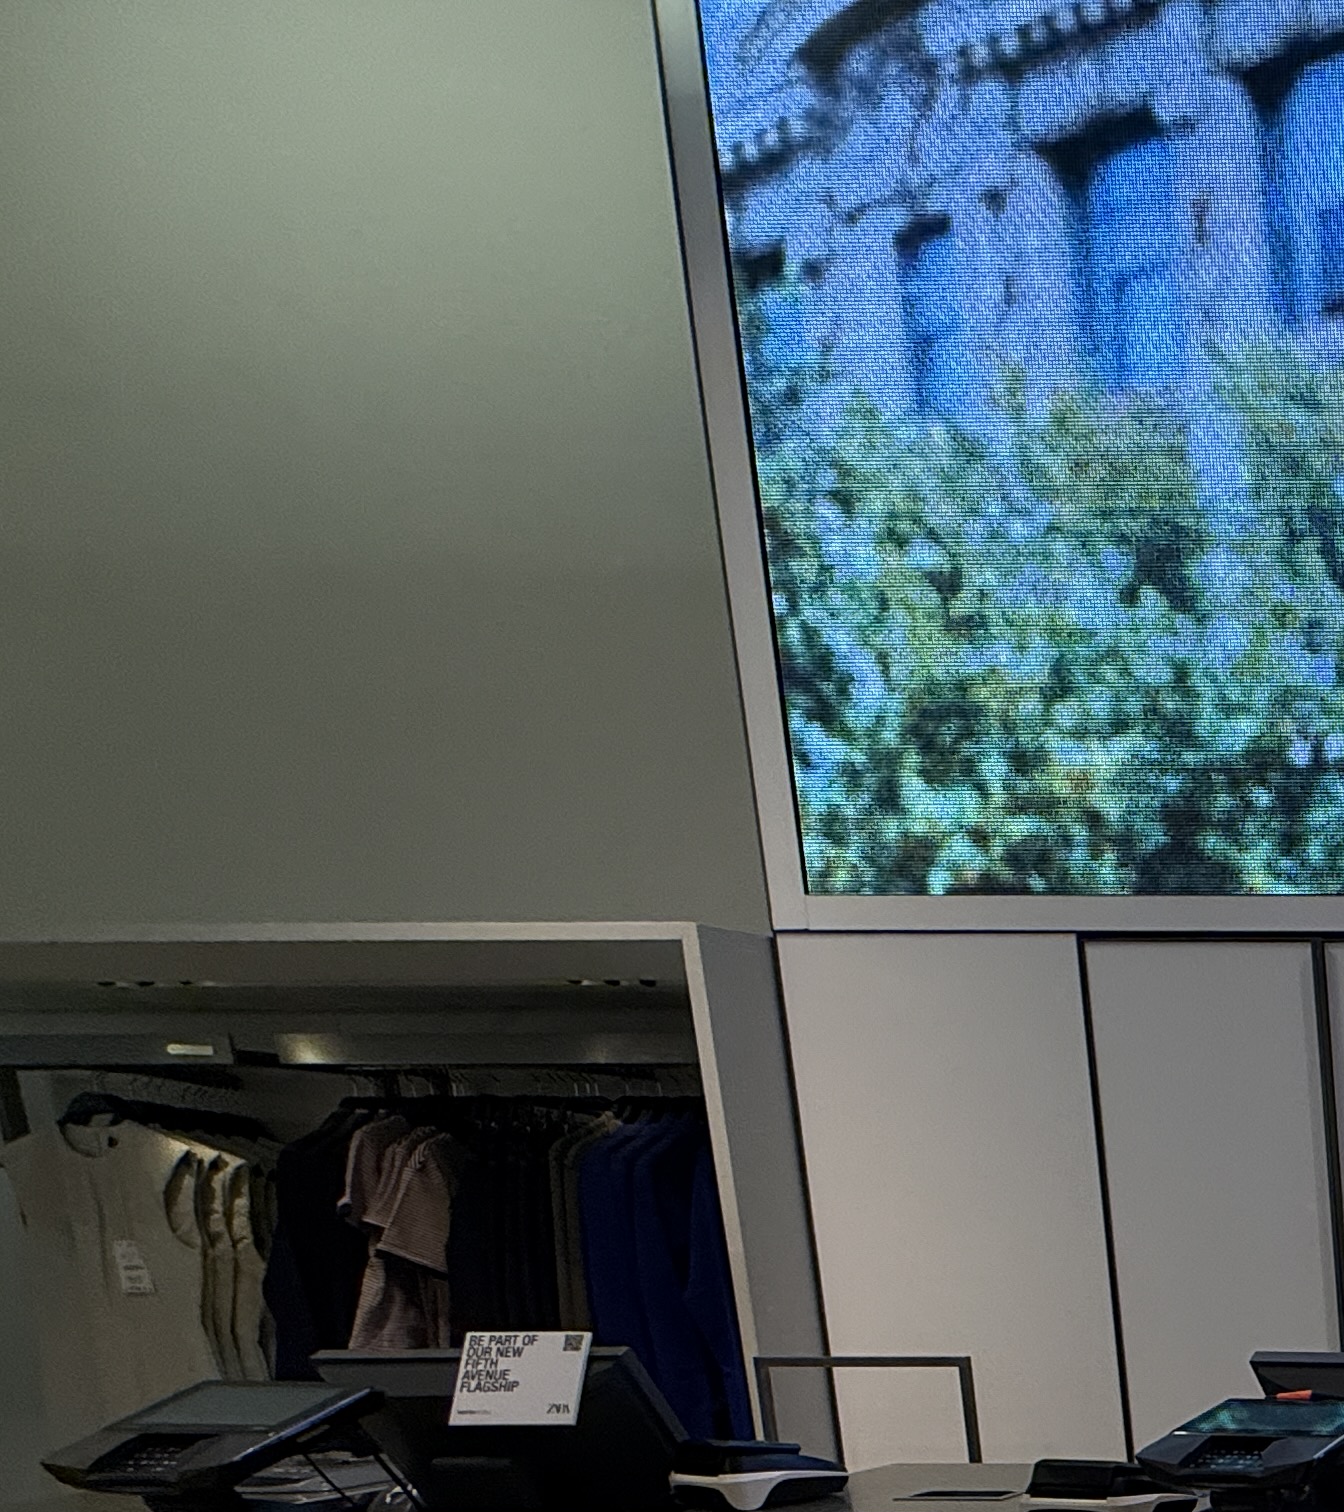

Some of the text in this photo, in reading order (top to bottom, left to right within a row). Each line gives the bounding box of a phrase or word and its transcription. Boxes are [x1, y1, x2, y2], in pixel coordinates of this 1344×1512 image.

[469, 1334, 539, 1346] BE PART OF
[466, 1346, 524, 1358] OUR NEW
[464, 1358, 499, 1369] FIFTH
[461, 1369, 511, 1381] AVENUE
[460, 1380, 520, 1393] FLAGSHIP
